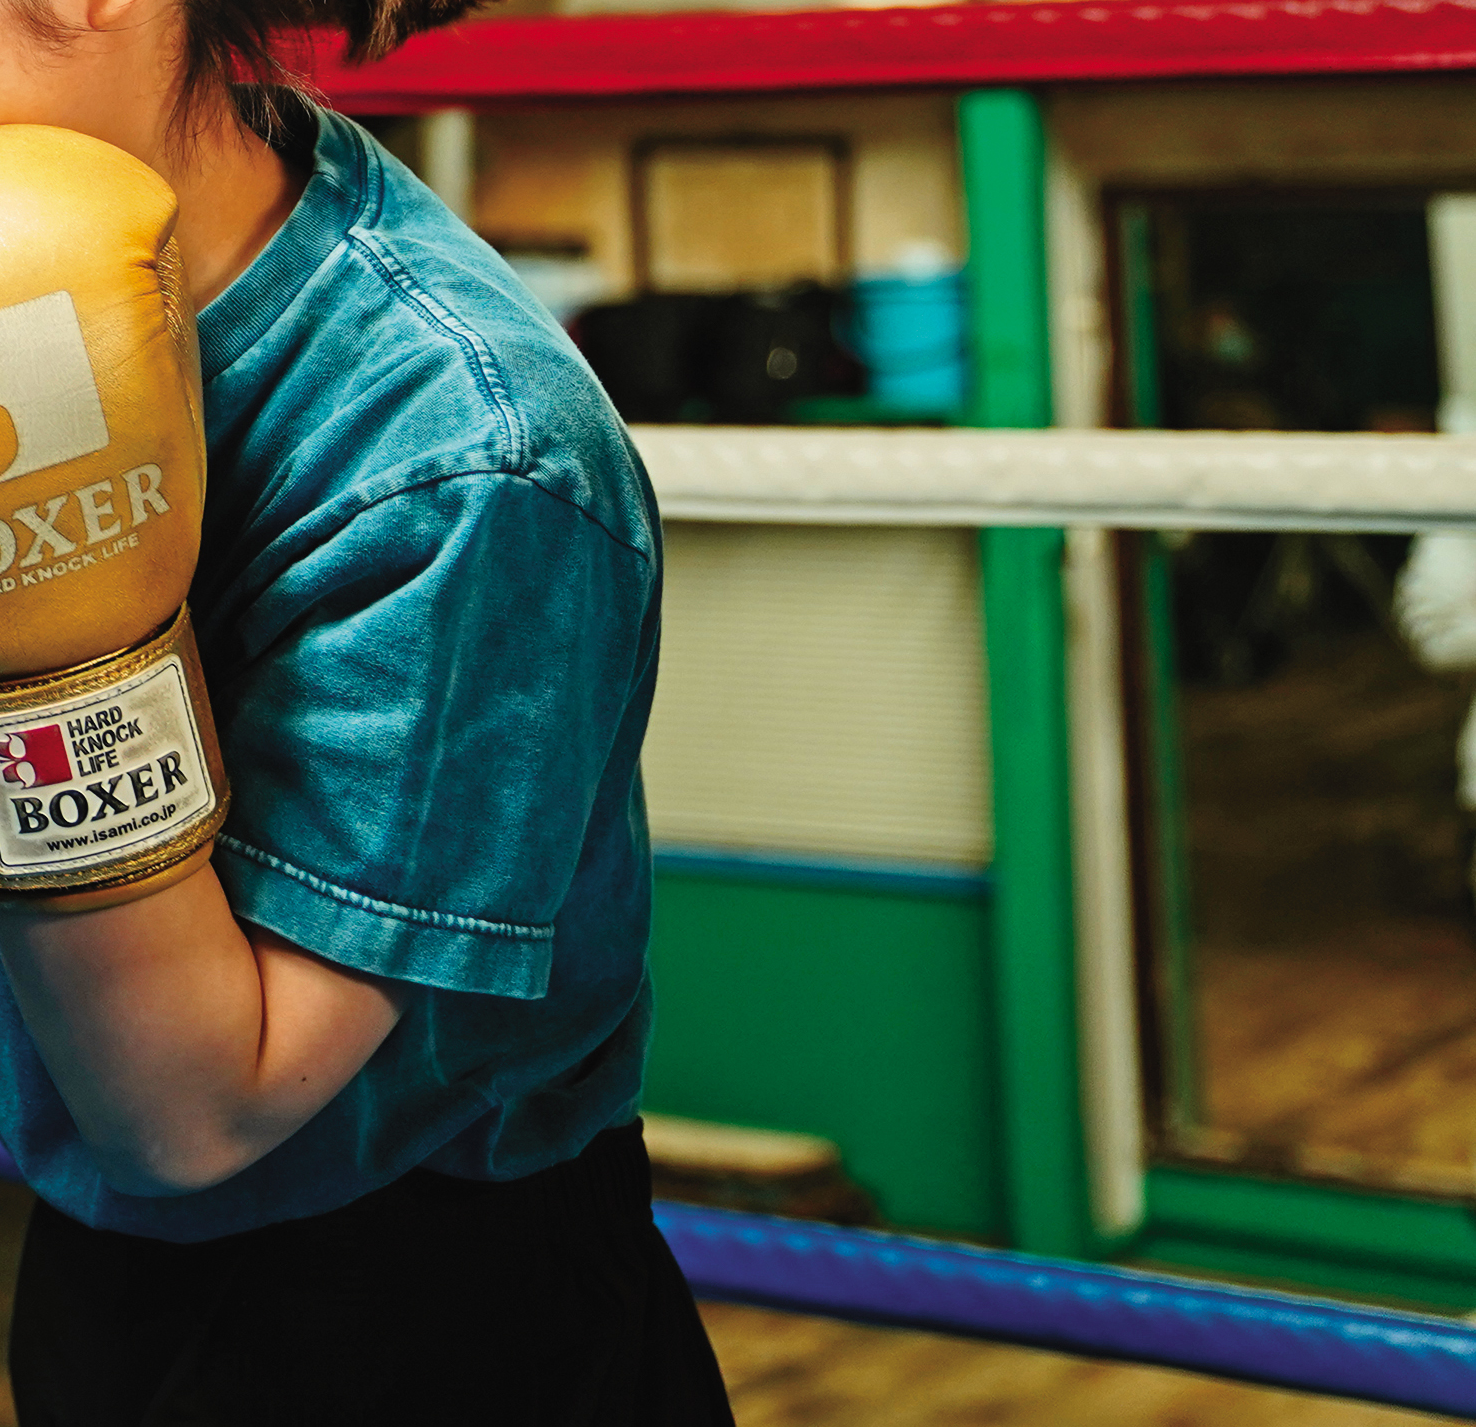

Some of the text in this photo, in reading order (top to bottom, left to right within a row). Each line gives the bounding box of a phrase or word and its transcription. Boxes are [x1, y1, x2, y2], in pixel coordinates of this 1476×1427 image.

[22, 553, 97, 586] KNOCK
[102, 532, 140, 559] LIFE
[67, 706, 123, 738] HARD
[72, 718, 143, 758] KNOCK
[77, 749, 120, 777] LIFE
[10, 751, 188, 834] BOXER
